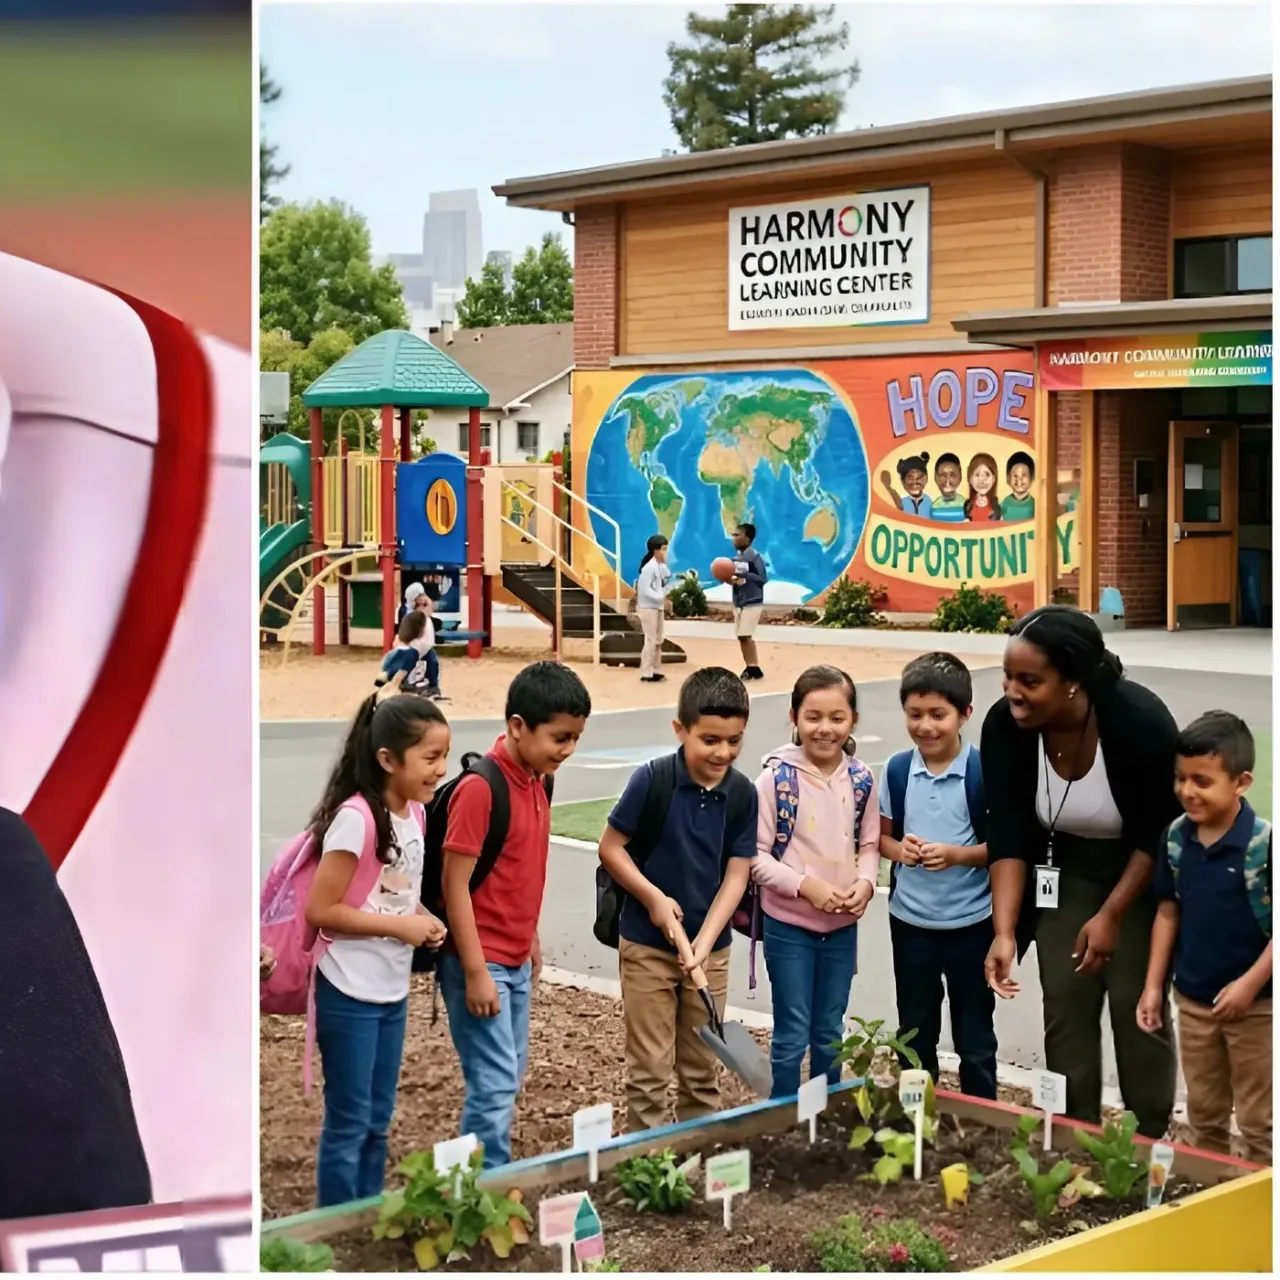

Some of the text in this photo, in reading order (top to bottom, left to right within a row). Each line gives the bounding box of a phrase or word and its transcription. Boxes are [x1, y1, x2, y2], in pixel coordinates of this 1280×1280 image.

[740, 199, 915, 246] HARMONY
[740, 237, 914, 278] COMMUNITY
[740, 271, 914, 302] LEARNING CENTER
[885, 367, 1035, 438] HOPE
[870, 519, 1074, 580] OPPORTUNIY
